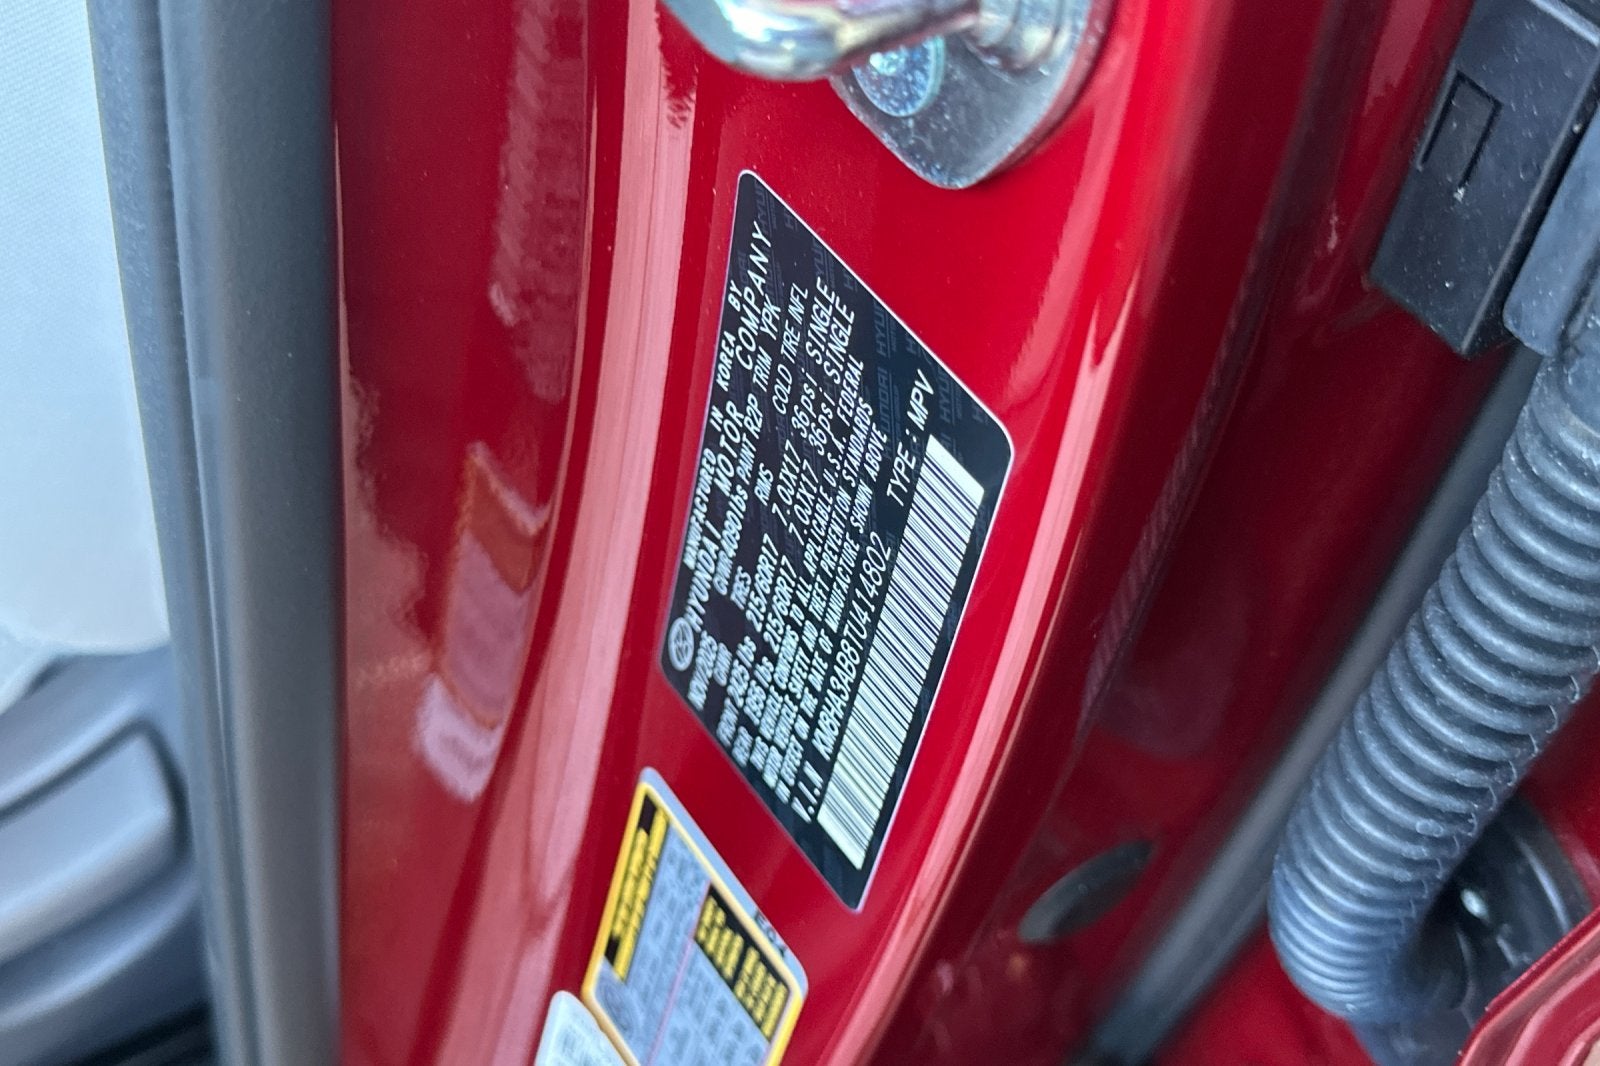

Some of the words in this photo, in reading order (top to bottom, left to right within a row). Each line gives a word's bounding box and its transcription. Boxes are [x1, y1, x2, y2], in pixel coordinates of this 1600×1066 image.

[727, 279, 742, 312] BY
[759, 293, 781, 340] YPK
[787, 282, 808, 325] INFL
[715, 400, 745, 497] MOTOR
[734, 221, 771, 370] COMPANY
[715, 330, 736, 392] KOREA
[779, 318, 801, 364] TIRE
[751, 345, 772, 392] TRIM
[771, 363, 793, 415] COLD
[836, 354, 864, 426] FEDERAL
[709, 404, 724, 432] IN
[742, 392, 763, 439] R2P
[735, 432, 756, 485] PAINT
[745, 533, 778, 632] 215/60R17
[771, 439, 801, 526] 7.0JX17
[805, 276, 837, 365] SINGLE
[823, 436, 847, 487] U.S.A.
[841, 396, 873, 487] STANDARDS
[863, 422, 888, 482] ABOVE
[753, 462, 774, 506] RIMS
[763, 554, 797, 654] 215/60R17
[787, 458, 819, 545] 7.0JX17
[822, 296, 855, 384] SINGLE
[802, 485, 833, 577] APPLICABLE
[819, 485, 851, 578] PREVENTION
[849, 478, 873, 534] SHOWN
[812, 532, 890, 760] KM8HA3AB8TU414802
[886, 441, 916, 506] TYPE
[906, 368, 934, 431] MPV
[824, 531, 860, 633] MANUFACTURE
[789, 604, 805, 624] TO
[795, 575, 813, 607] ALL
[808, 574, 830, 621] THEFT
[801, 619, 818, 652] AND
[817, 627, 834, 655] OF
[787, 646, 810, 699] SAFETY
[807, 650, 828, 692] DATE
[799, 686, 818, 718] THE
